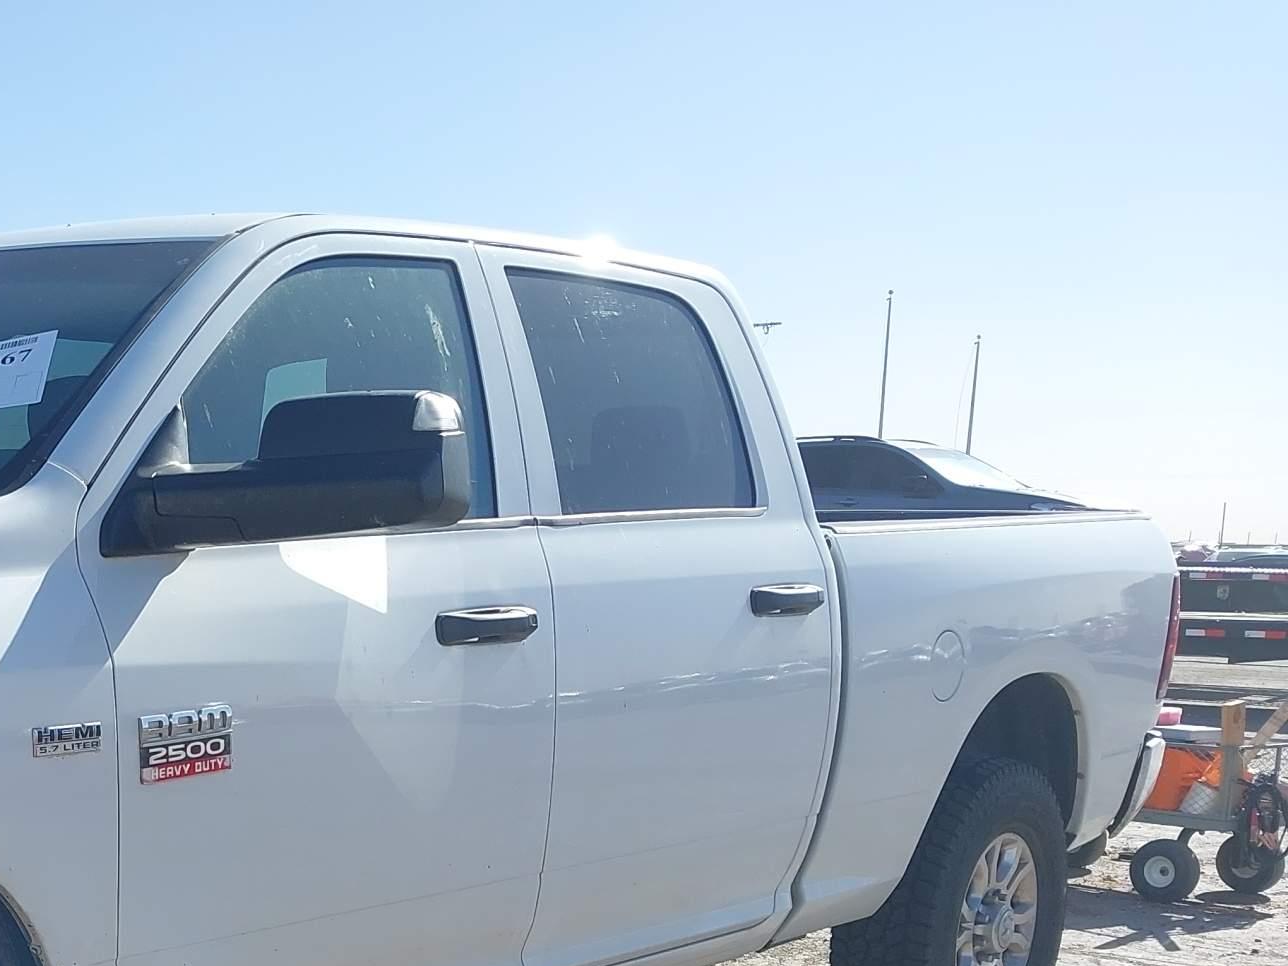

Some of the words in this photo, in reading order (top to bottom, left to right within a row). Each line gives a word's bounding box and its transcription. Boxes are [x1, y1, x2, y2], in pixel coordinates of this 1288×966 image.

[37, 724, 102, 744] HEMI
[138, 704, 232, 743] RAM
[39, 744, 59, 754] 5.7
[63, 740, 99, 752] LITER
[148, 738, 225, 766] 2500
[152, 763, 191, 780] HEAVY
[195, 757, 224, 773] DUTY
